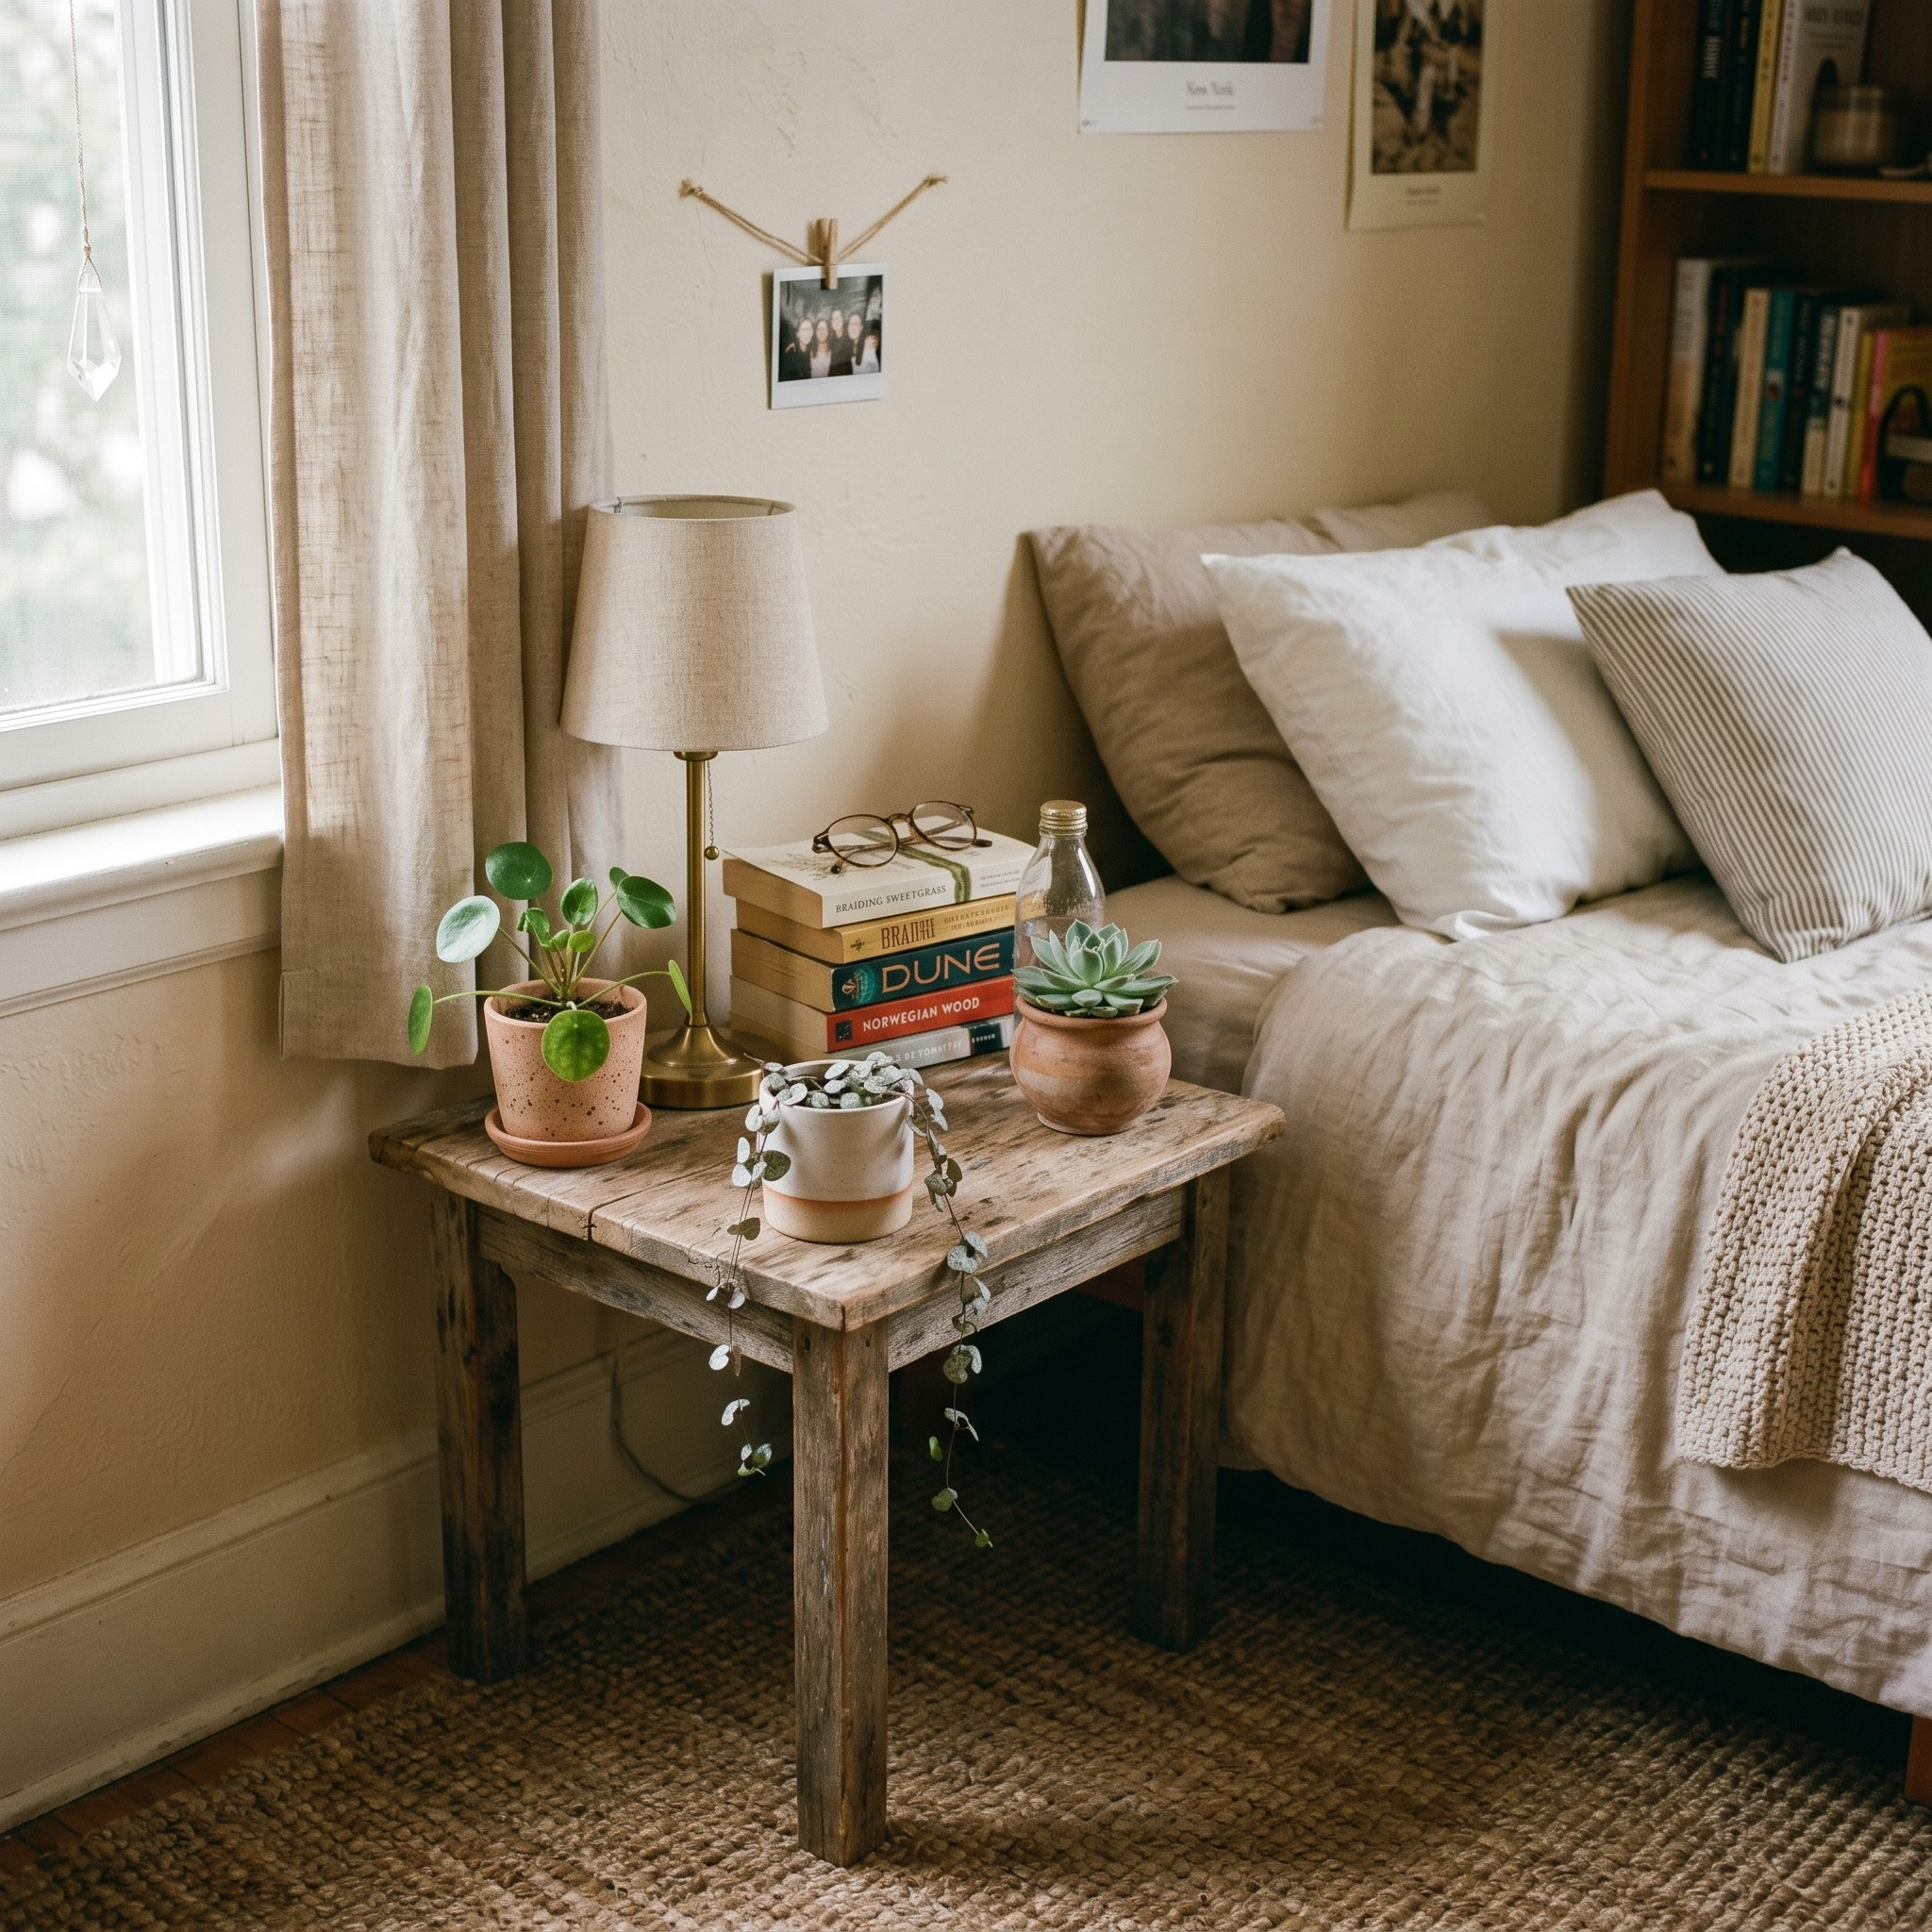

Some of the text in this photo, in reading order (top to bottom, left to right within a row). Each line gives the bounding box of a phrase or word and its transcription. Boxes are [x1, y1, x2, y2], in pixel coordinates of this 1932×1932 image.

[835, 885, 947, 914] BRAIDING SWEETGRASS
[882, 942, 1001, 994] DUNE
[862, 997, 980, 1032] NORWEGIAN WOOD
